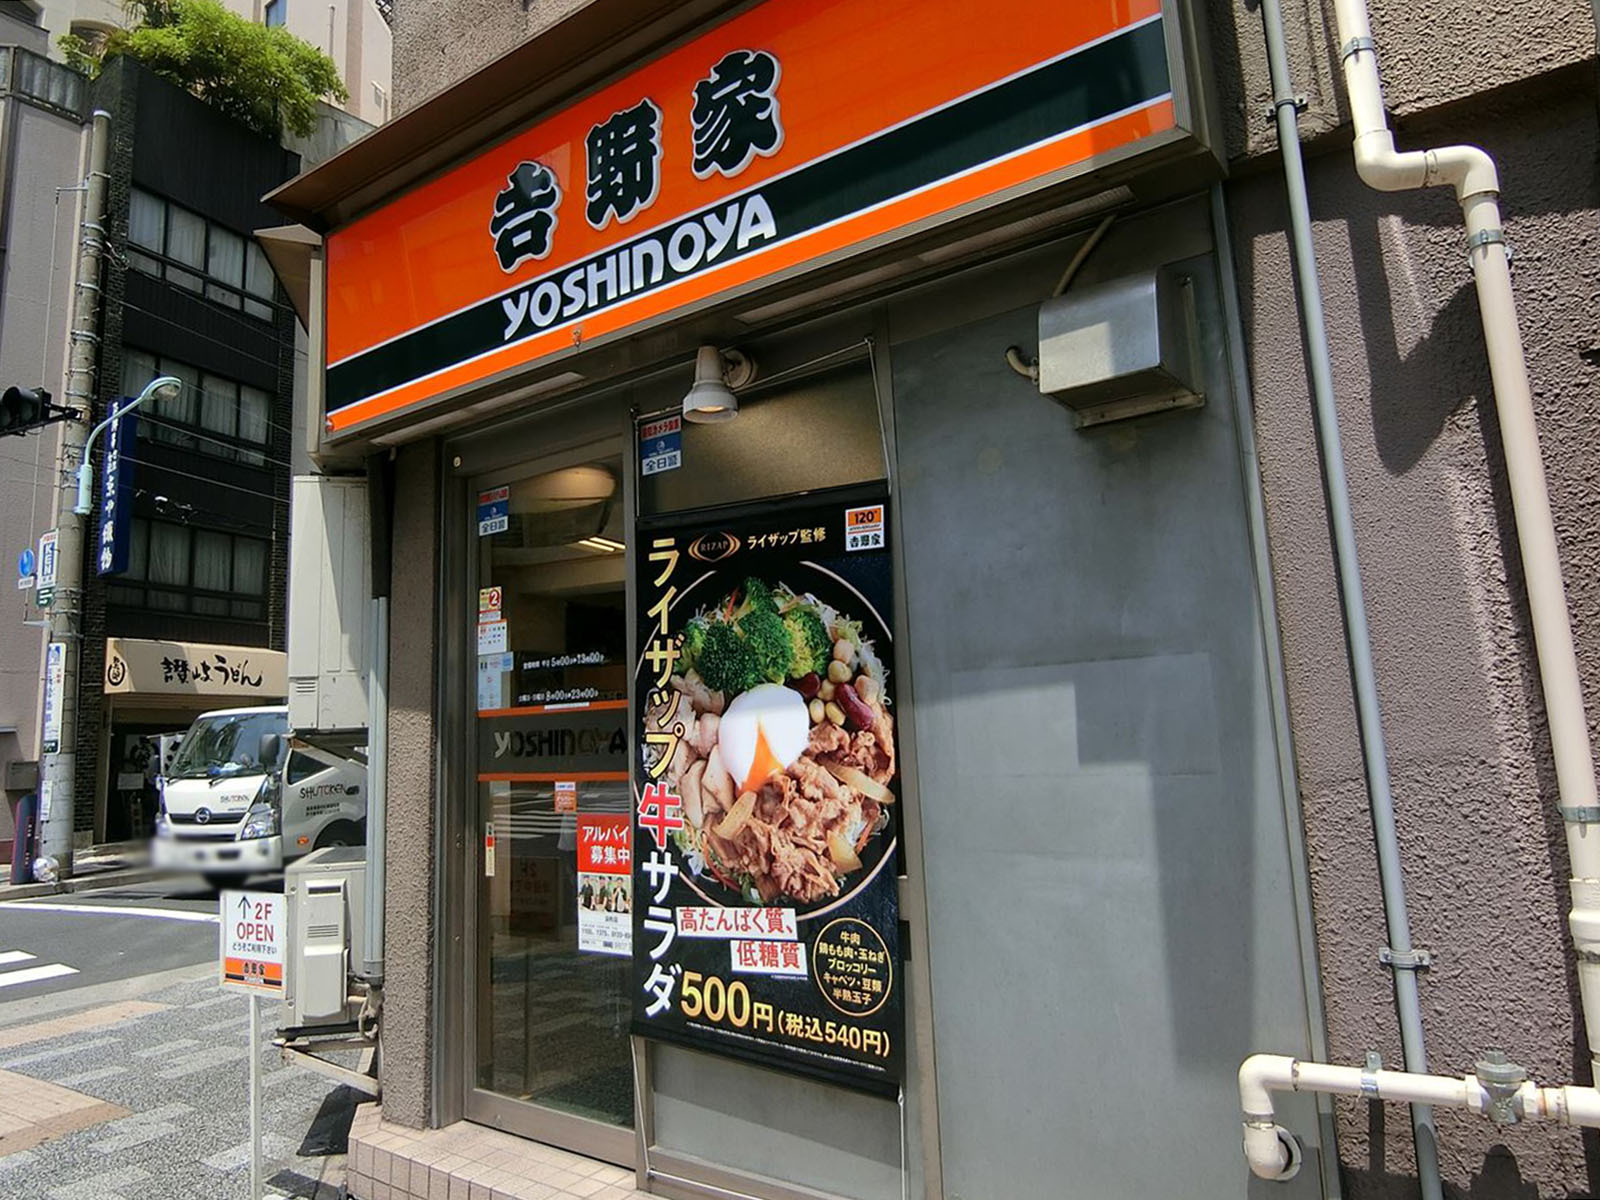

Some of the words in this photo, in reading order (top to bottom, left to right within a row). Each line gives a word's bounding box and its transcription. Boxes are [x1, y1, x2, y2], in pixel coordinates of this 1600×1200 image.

[489, 50, 784, 274] 吉野家
[501, 193, 777, 341] YOSHINOYA
[700, 540, 728, 552] RIZAP
[747, 527, 826, 550] ライザップ監修
[160, 654, 263, 688] 讃岐うどん
[590, 845, 630, 865] 募集中
[255, 902, 272, 920] 2F
[236, 922, 274, 942] OPEN
[840, 931, 861, 945] 牛肉
[737, 940, 800, 968] 低糖質
[828, 958, 877, 975] ブロッコリー
[833, 988, 872, 1005] 半熟玉子
